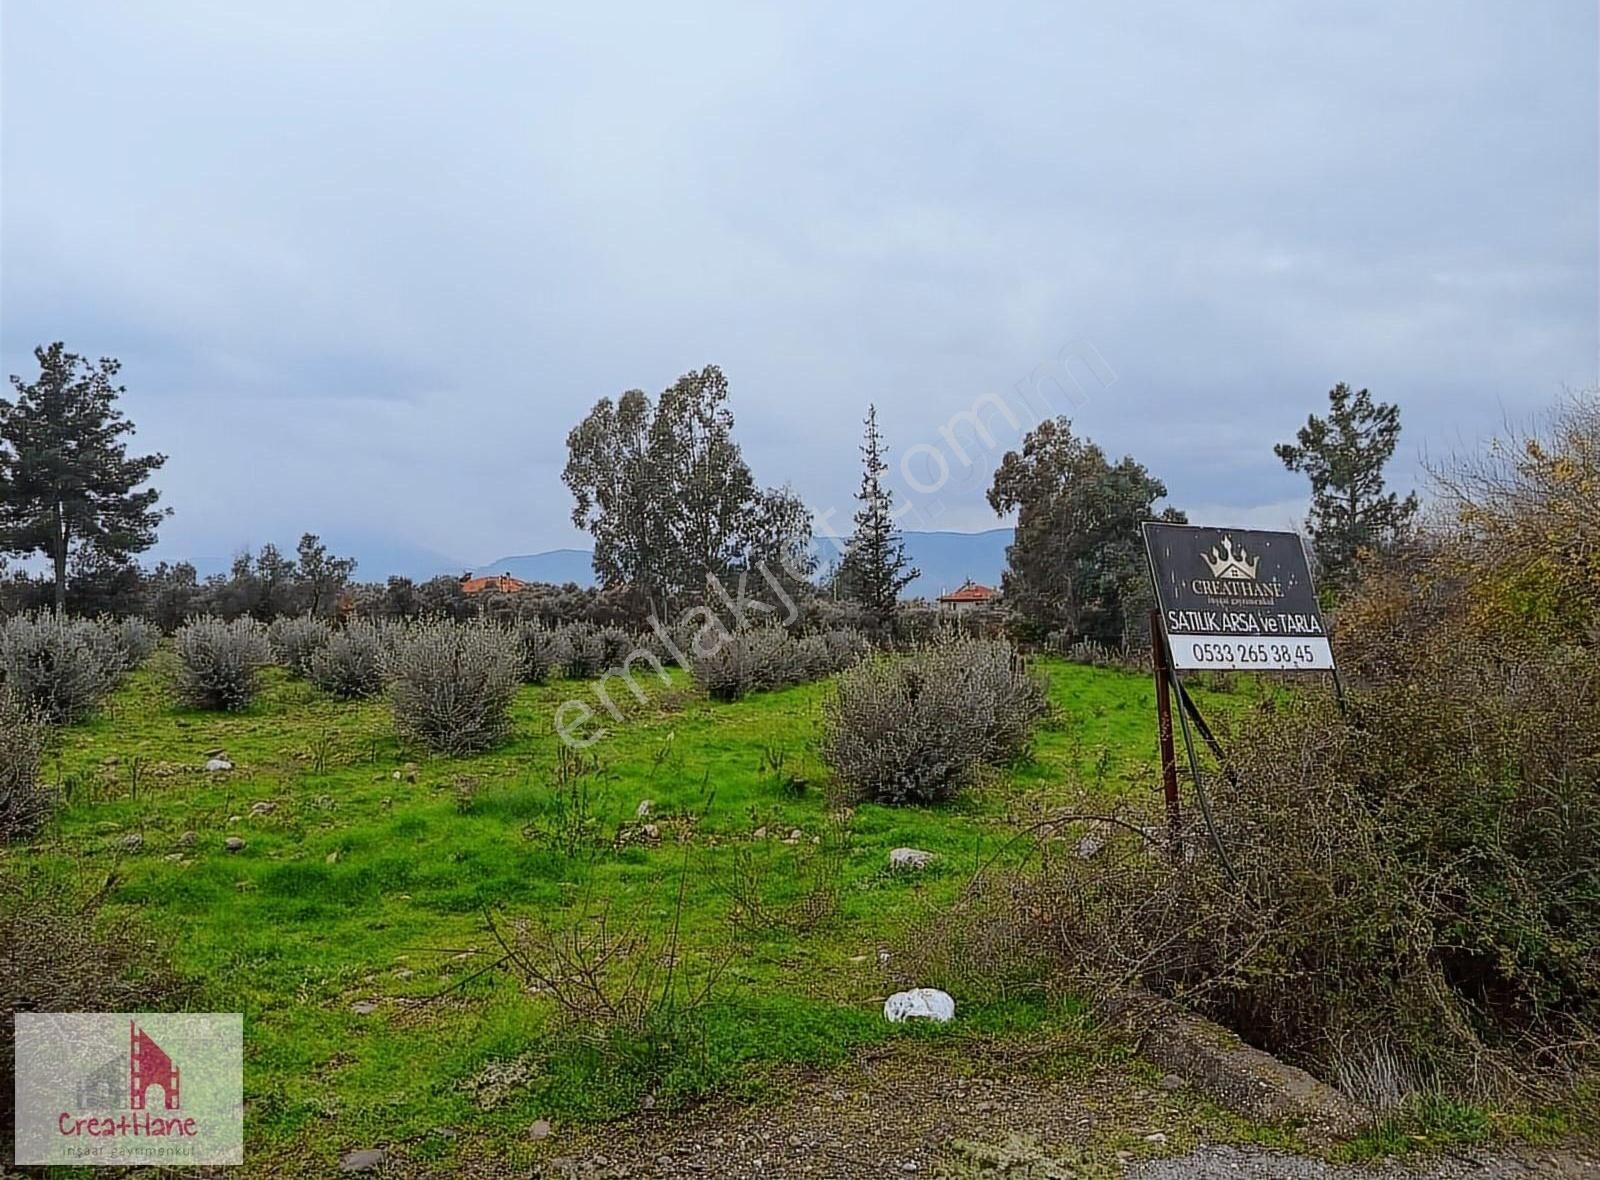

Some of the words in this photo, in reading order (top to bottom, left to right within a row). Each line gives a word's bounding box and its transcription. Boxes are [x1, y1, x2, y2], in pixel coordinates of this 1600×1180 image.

[1192, 579, 1284, 597] CREATHANE
[1168, 611, 1221, 631] SATILIK
[1222, 612, 1259, 632] ARSA
[1261, 616, 1278, 632] ve
[1278, 614, 1322, 633] TARLA
[1192, 643, 1234, 662] 0533
[1237, 644, 1268, 662] 265
[1271, 644, 1291, 662] 38
[1295, 644, 1314, 662] 45
